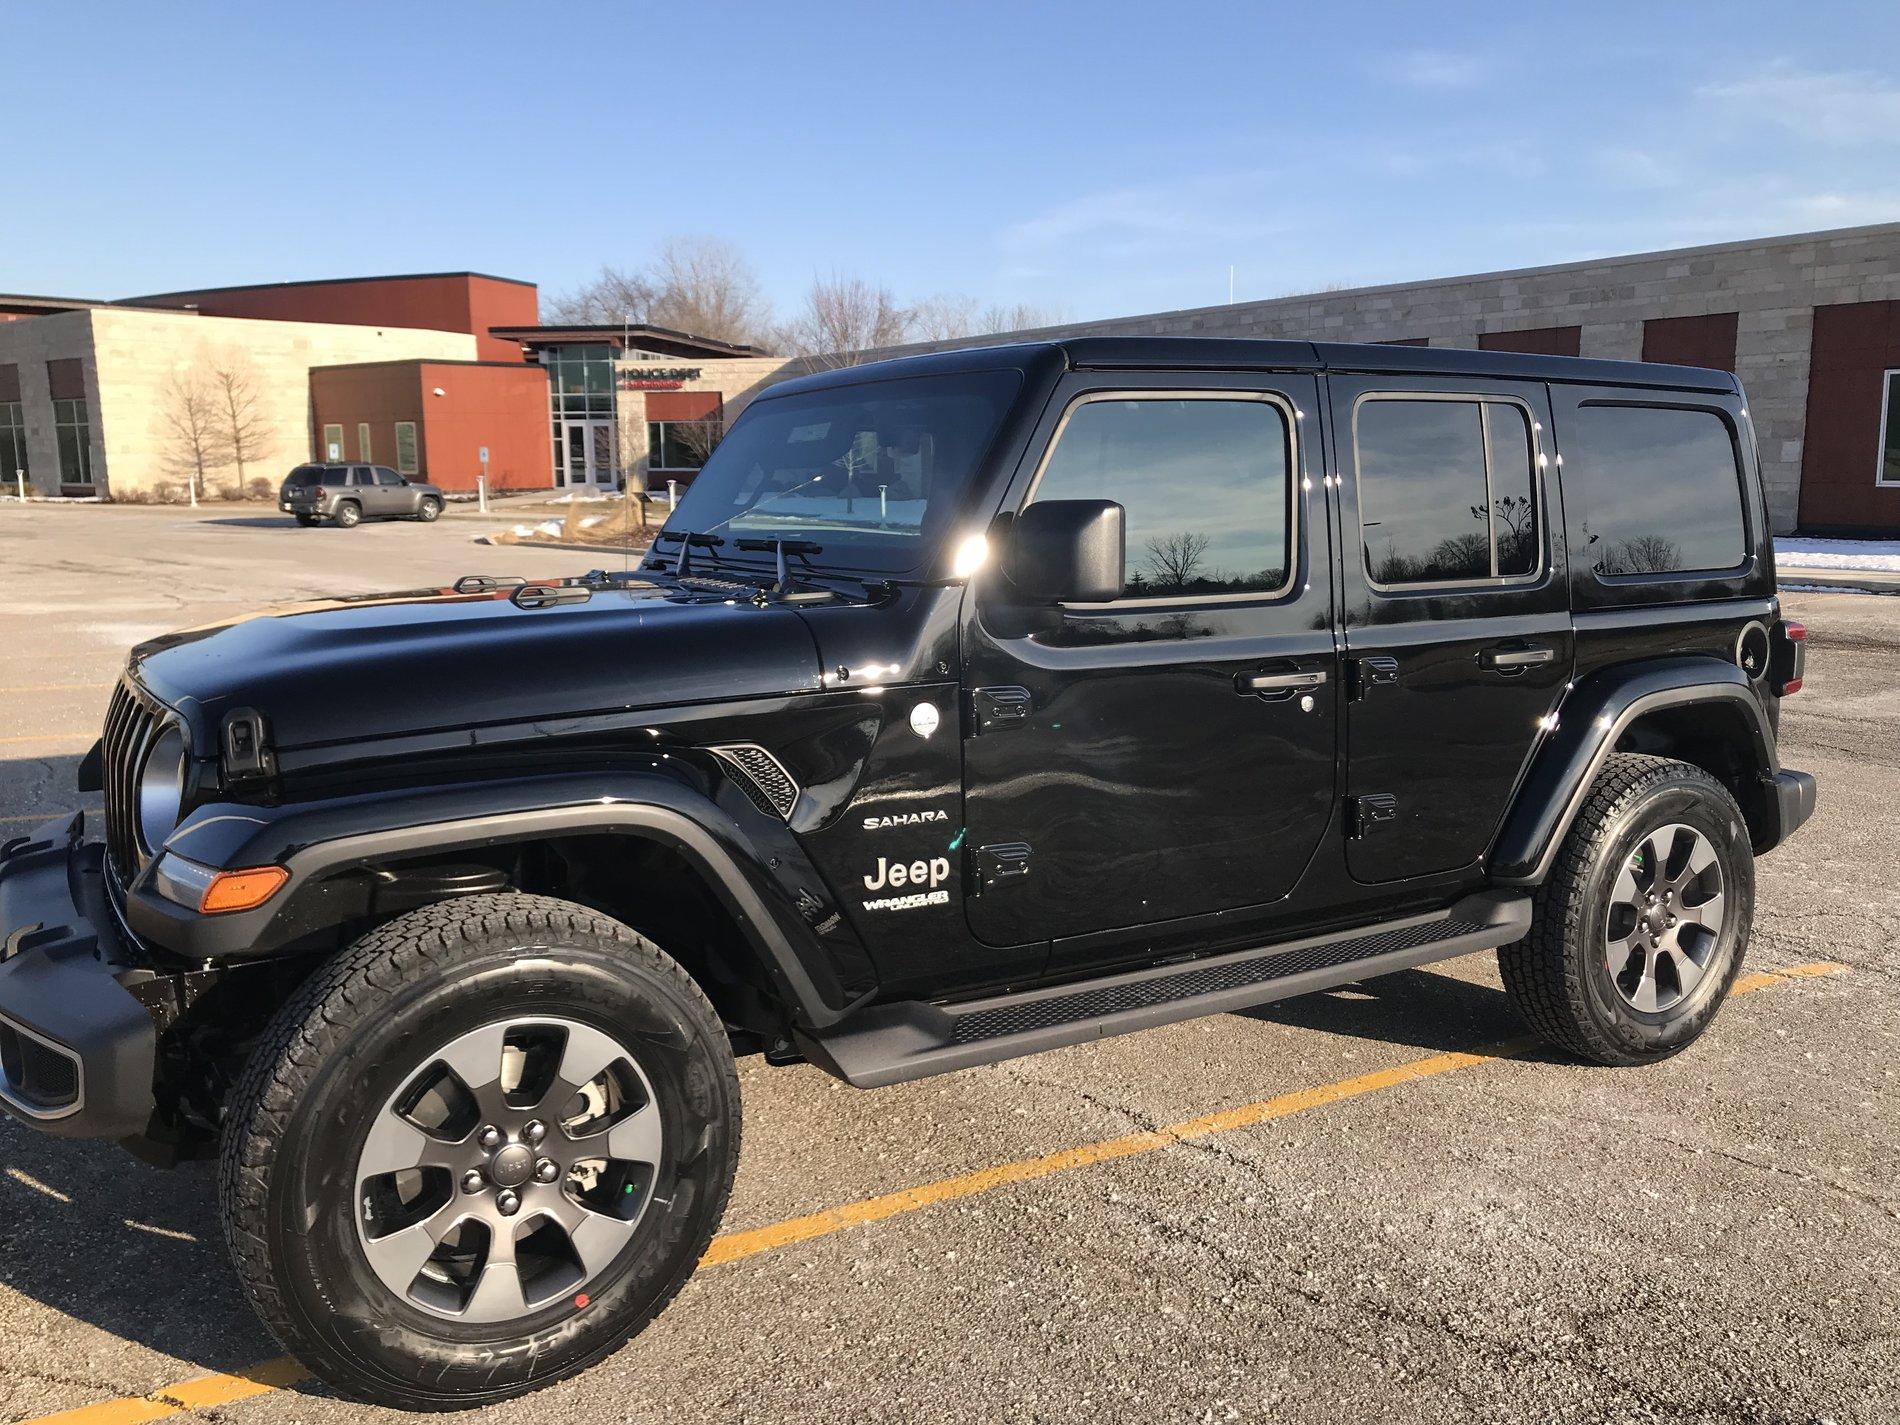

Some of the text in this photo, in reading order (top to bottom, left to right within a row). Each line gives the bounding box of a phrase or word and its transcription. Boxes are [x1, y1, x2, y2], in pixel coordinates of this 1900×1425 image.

[623, 367, 670, 380] POLICE
[862, 810, 949, 830] SAHARA
[863, 857, 950, 891] Jeep
[862, 890, 949, 911] WRANGLER
